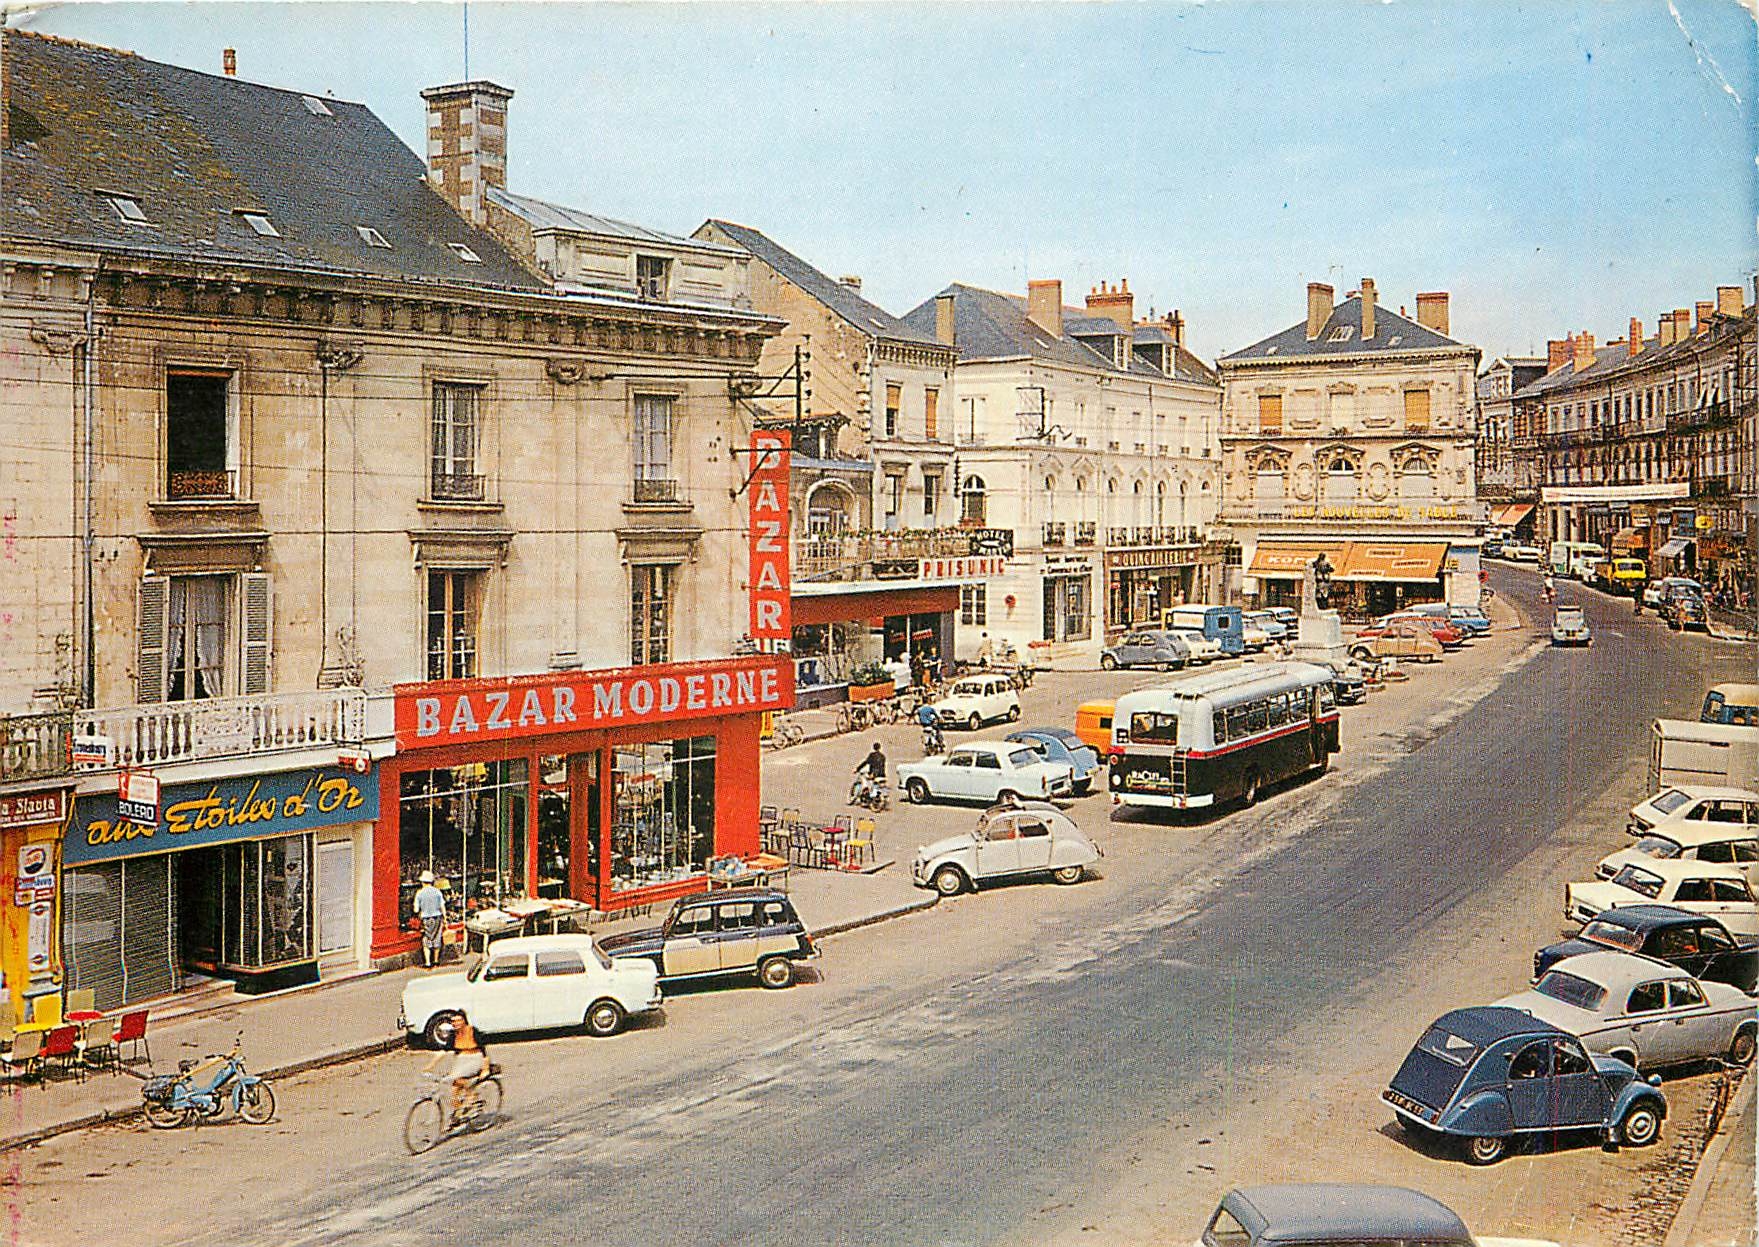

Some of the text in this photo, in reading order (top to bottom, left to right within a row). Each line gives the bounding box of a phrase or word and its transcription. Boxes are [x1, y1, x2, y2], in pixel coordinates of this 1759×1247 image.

[755, 437, 782, 630] BAZAR
[923, 558, 1005, 578] PRISUNIC
[416, 668, 781, 737] BAZAR MODERNE
[15, 797, 56, 815] Slavia
[118, 800, 155, 820] BOLERO
[165, 780, 276, 834] Etoiles
[283, 773, 364, 818] d'Or
